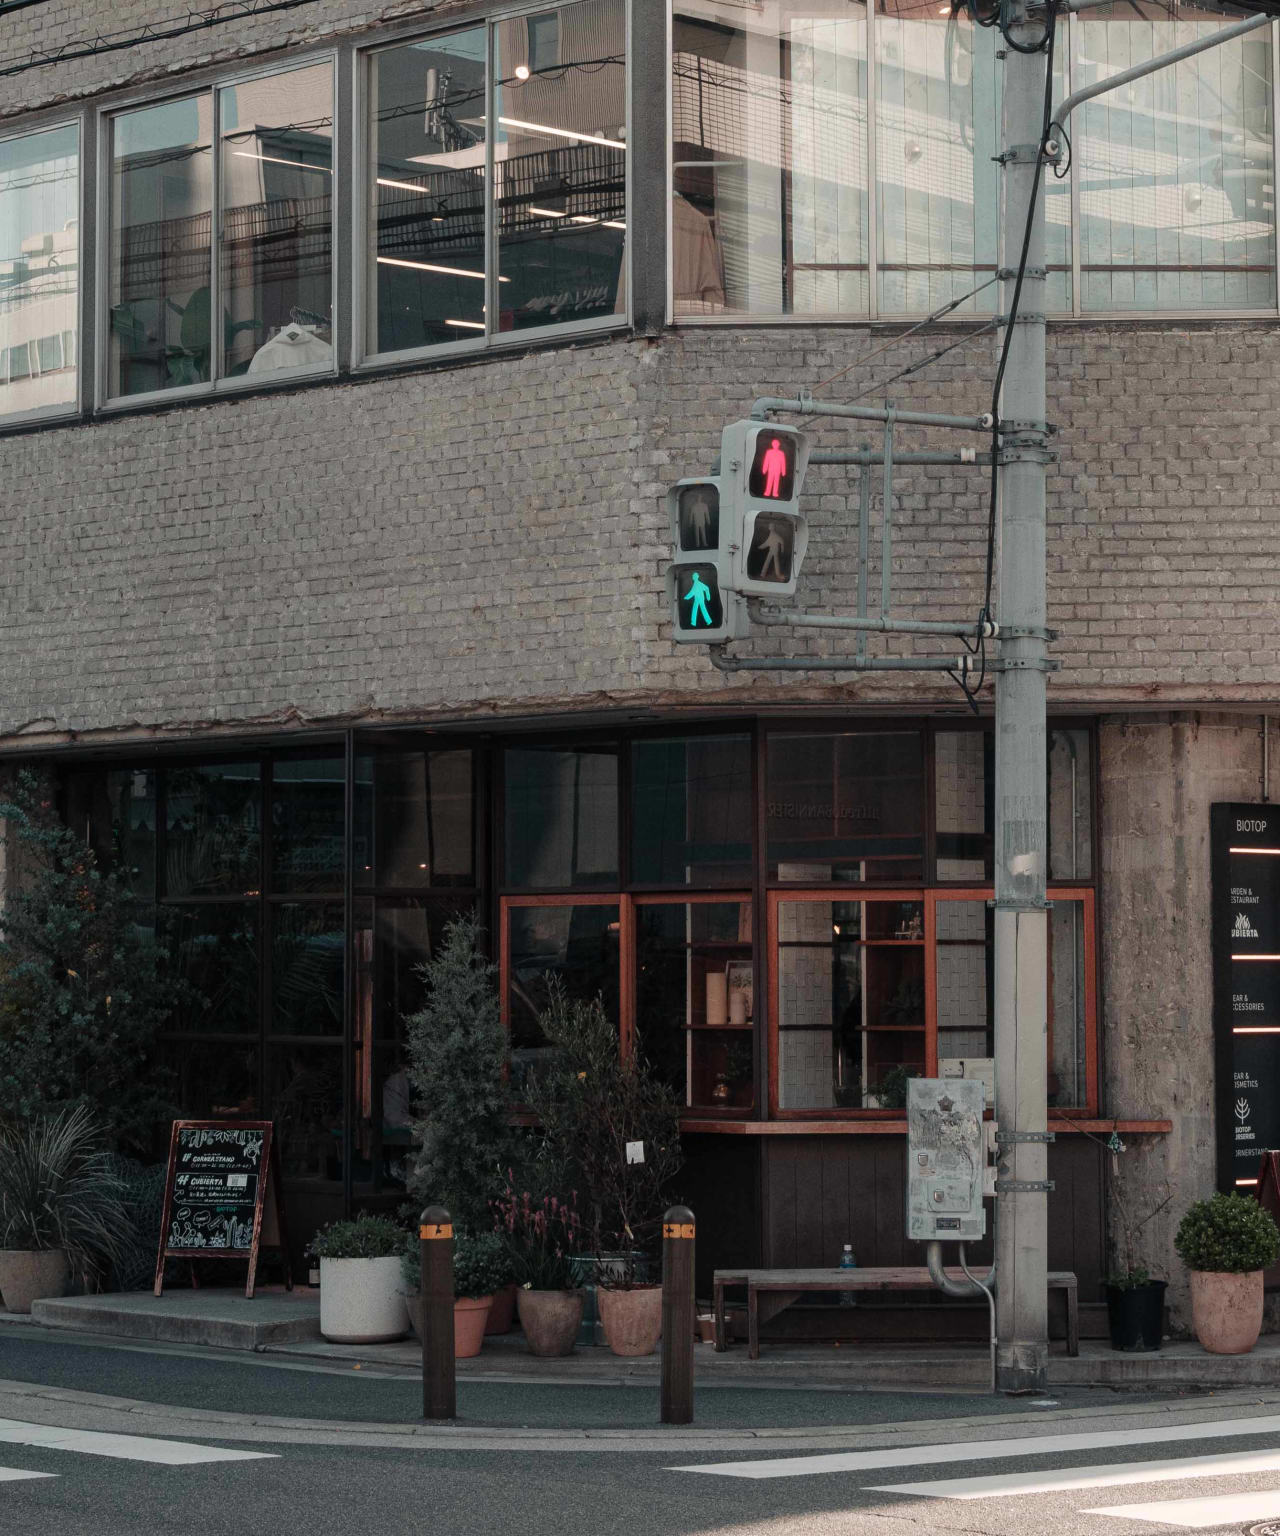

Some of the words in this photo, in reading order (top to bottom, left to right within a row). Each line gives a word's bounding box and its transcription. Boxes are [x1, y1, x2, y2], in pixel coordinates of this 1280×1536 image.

[1236, 819, 1267, 832] BIOTOP
[1230, 887, 1247, 895] ARDEN
[1231, 896, 1259, 904] ESTAURANT
[1231, 929, 1258, 938] UBIERTA
[1232, 994, 1244, 1002] EAR
[1232, 1002, 1265, 1011] CESSORIES
[1233, 1072, 1244, 1081] EAR
[1234, 1080, 1259, 1089] SMETICS
